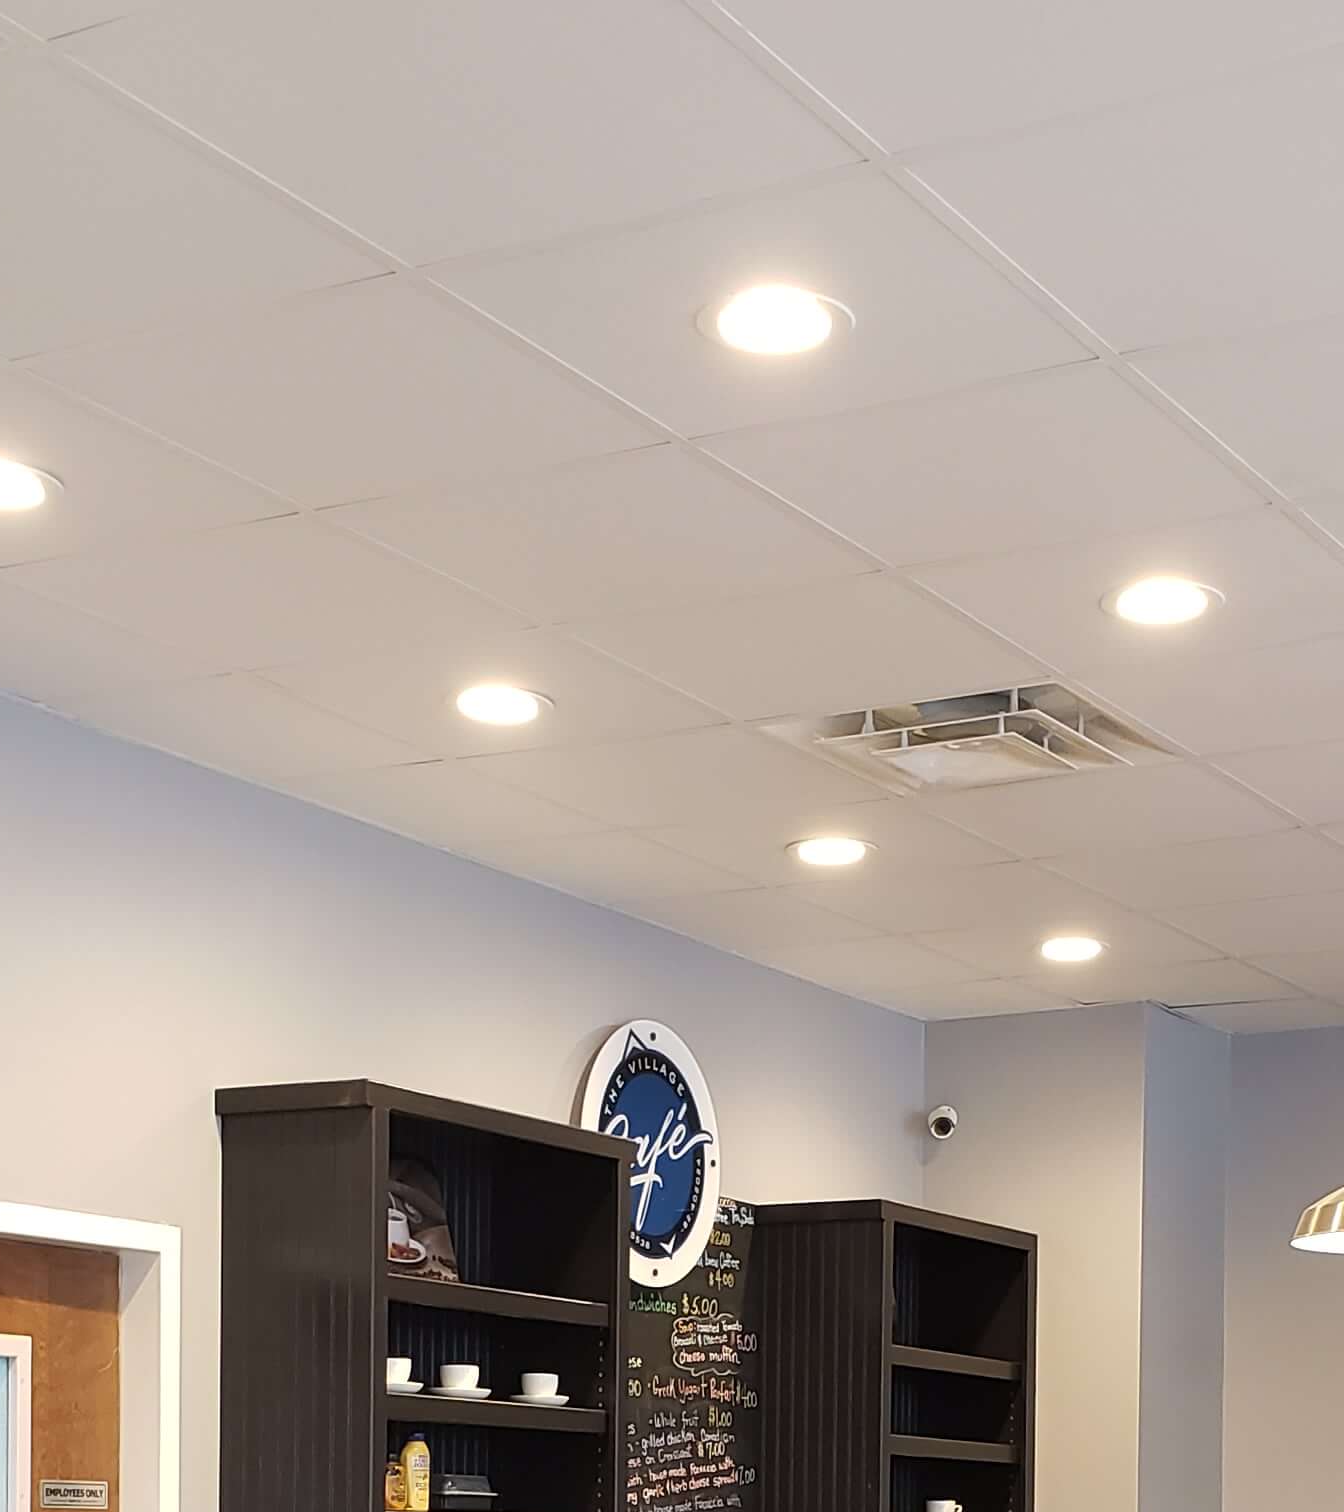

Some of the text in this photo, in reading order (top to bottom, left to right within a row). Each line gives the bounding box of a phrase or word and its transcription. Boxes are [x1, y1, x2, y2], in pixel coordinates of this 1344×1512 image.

[604, 1057, 686, 1116] THE VILLAGE
[682, 1292, 718, 1317] $5.00
[45, 1488, 104, 1498] EMPLOYEES ONLY
